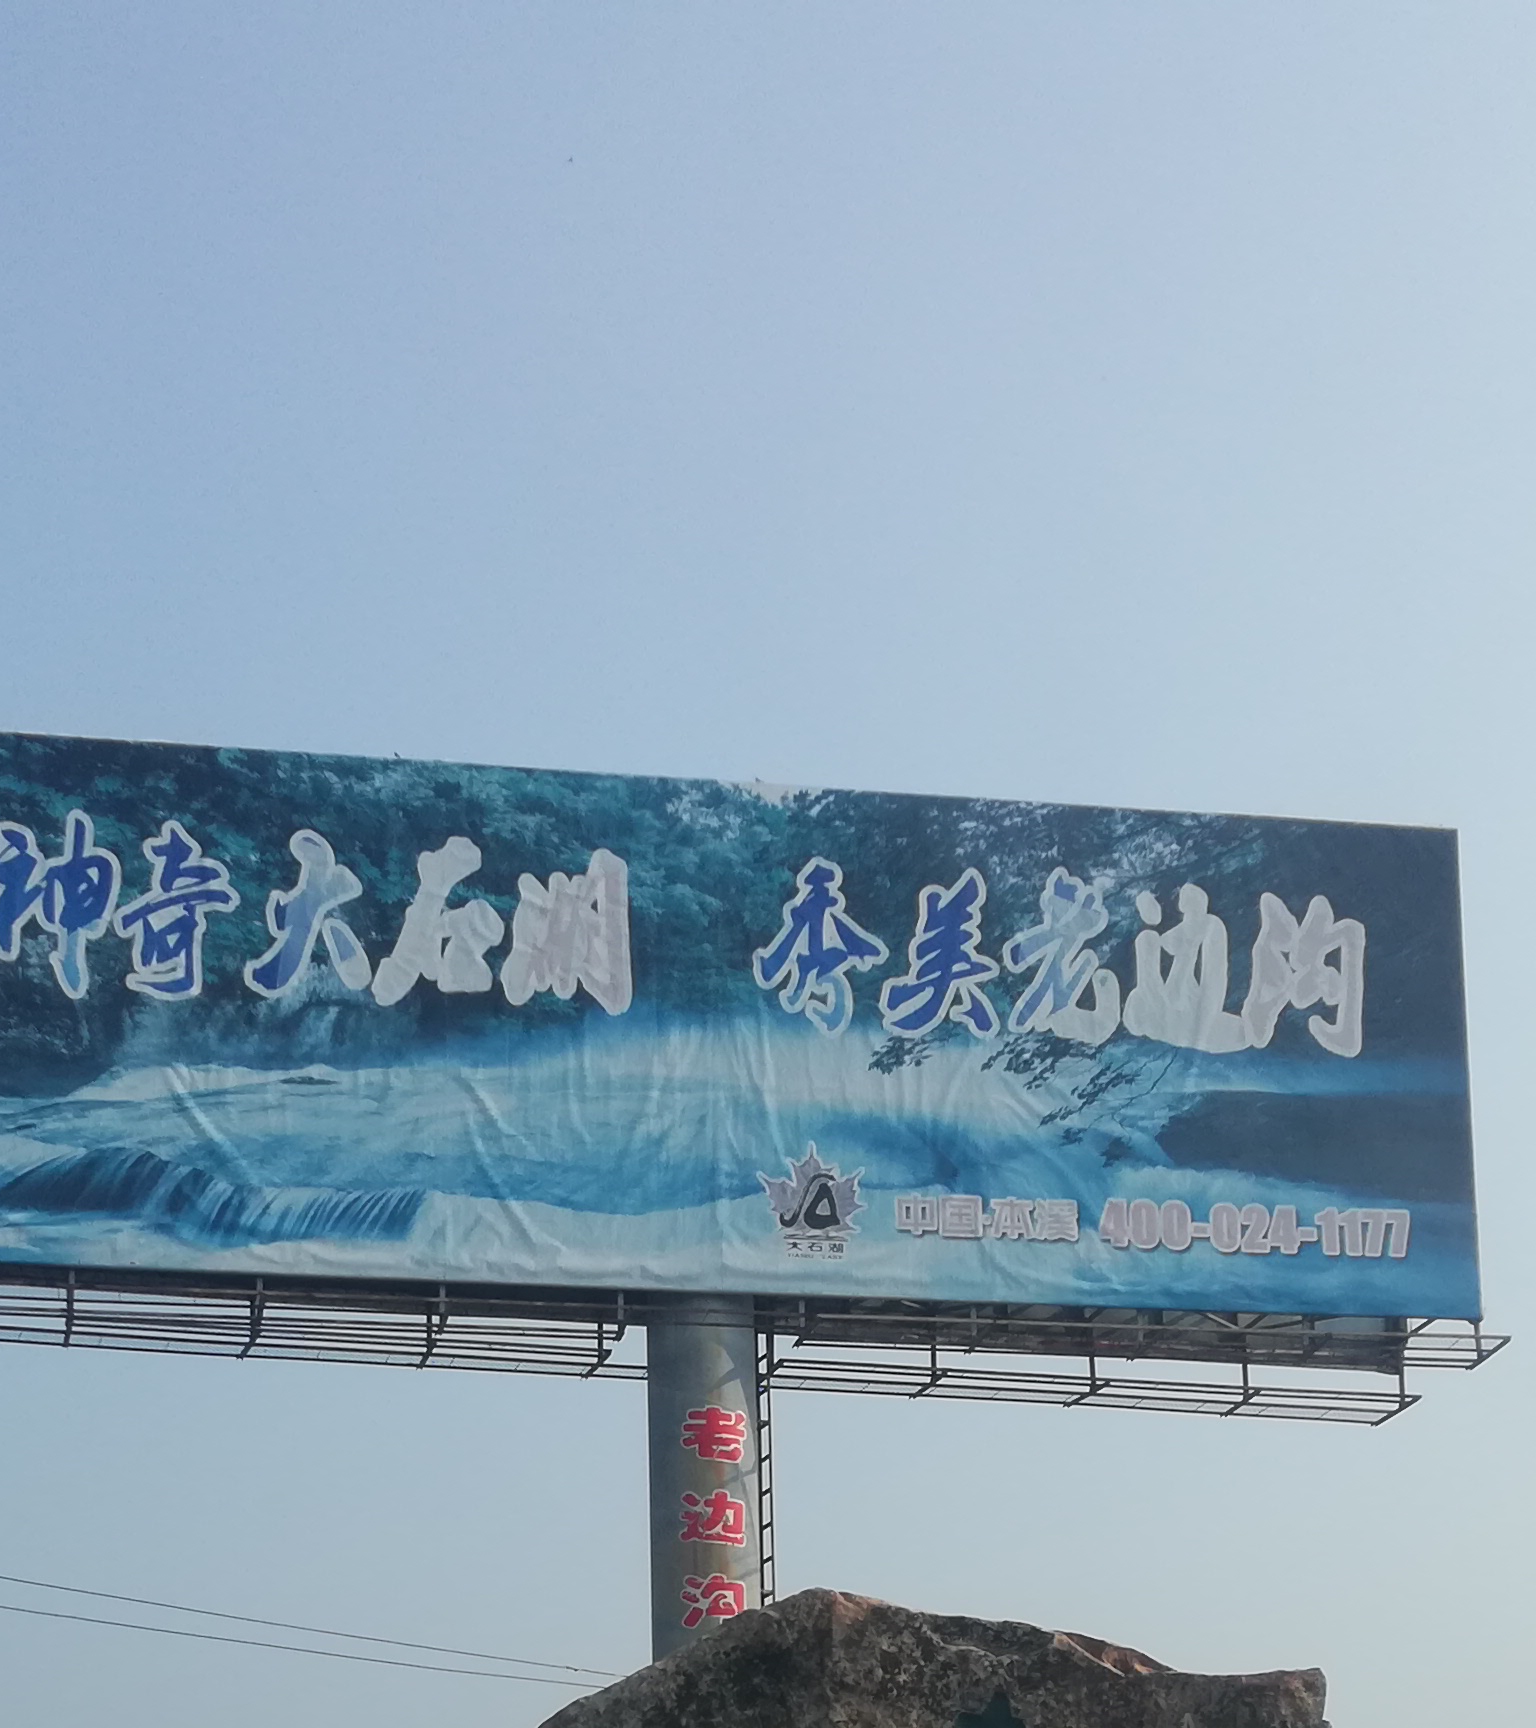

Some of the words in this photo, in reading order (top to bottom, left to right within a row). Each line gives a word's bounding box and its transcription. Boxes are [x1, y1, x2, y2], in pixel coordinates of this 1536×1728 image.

[752, 855, 1367, 1058] 秀美老边沟
[786, 1241, 845, 1254] 大石湖
[1098, 1197, 1412, 1259] 400-024-1177
[679, 1404, 747, 1629] 老边沟
